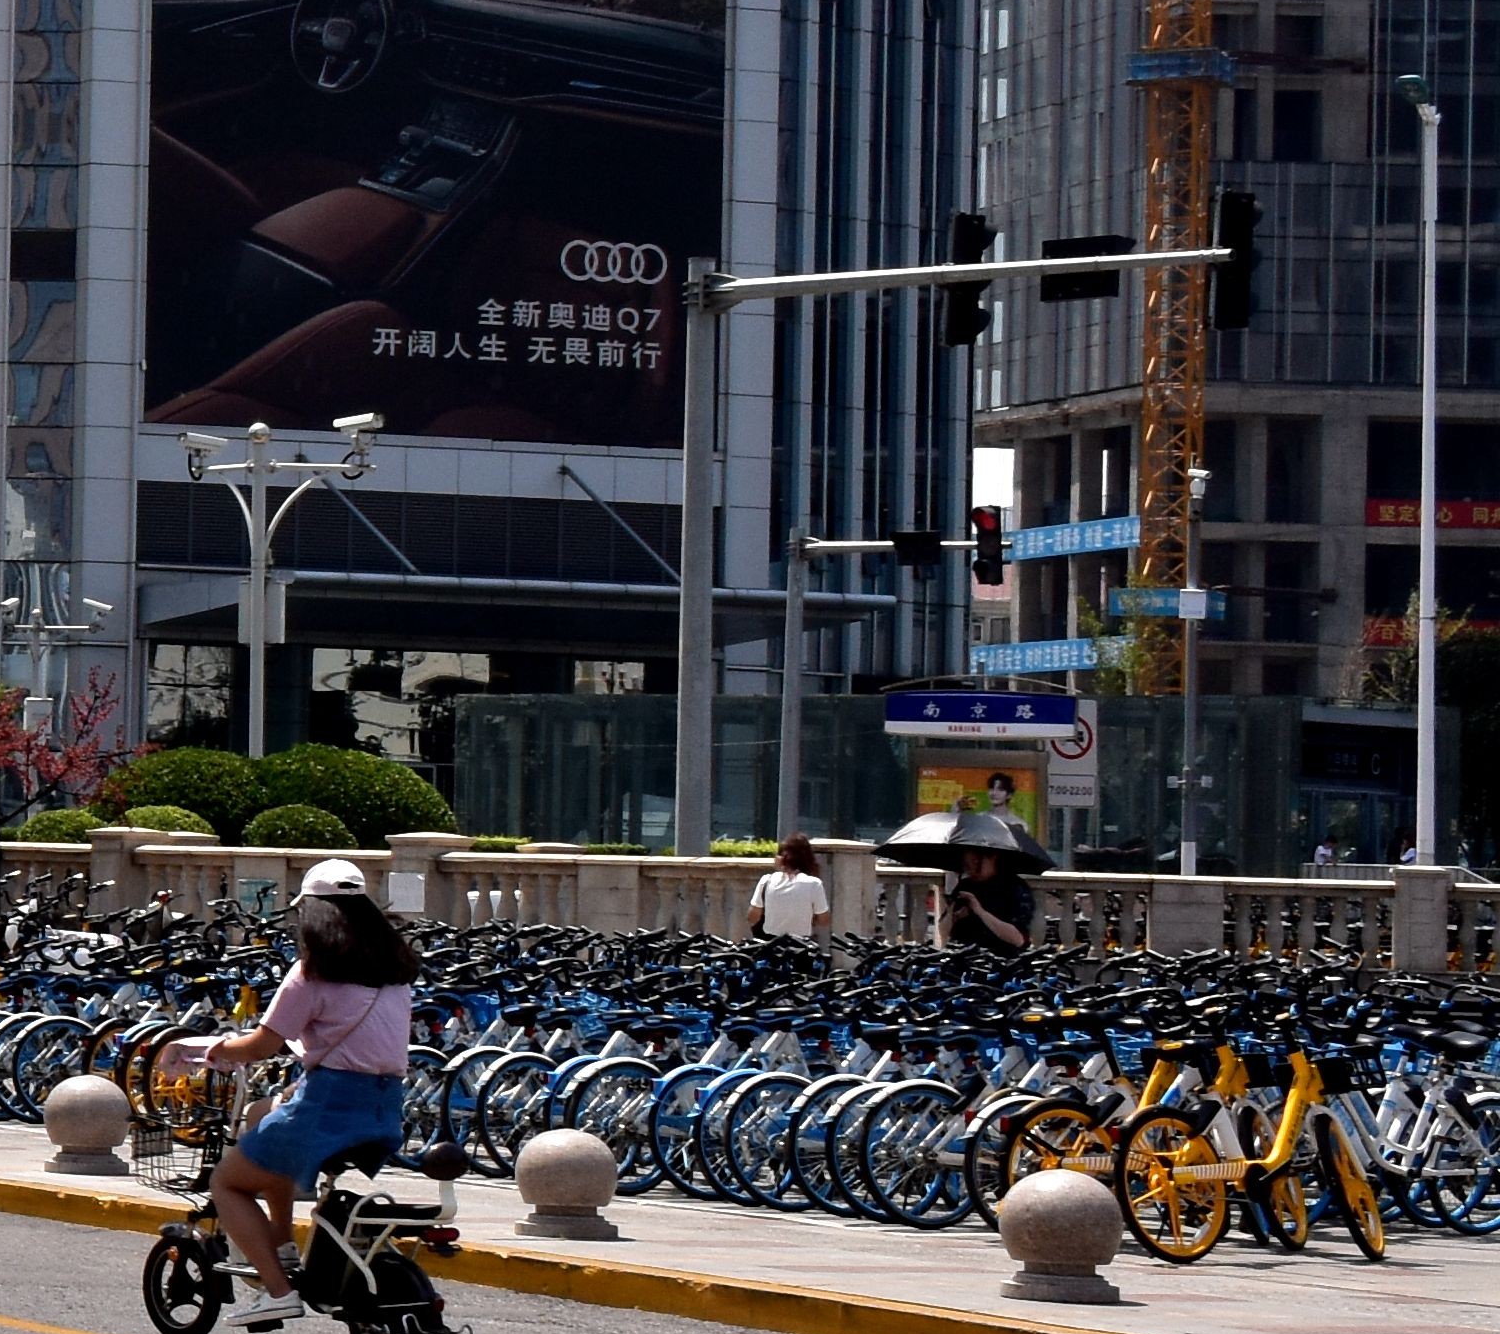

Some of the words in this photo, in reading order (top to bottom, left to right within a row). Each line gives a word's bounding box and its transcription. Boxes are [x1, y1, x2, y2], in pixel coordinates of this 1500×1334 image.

[477, 297, 662, 334] 全新奥迪Q7
[372, 327, 508, 363] 开阔人生
[527, 336, 662, 370] 无畏前行
[1379, 505, 1453, 523] 坚定心
[923, 700, 1036, 719] 南京路
